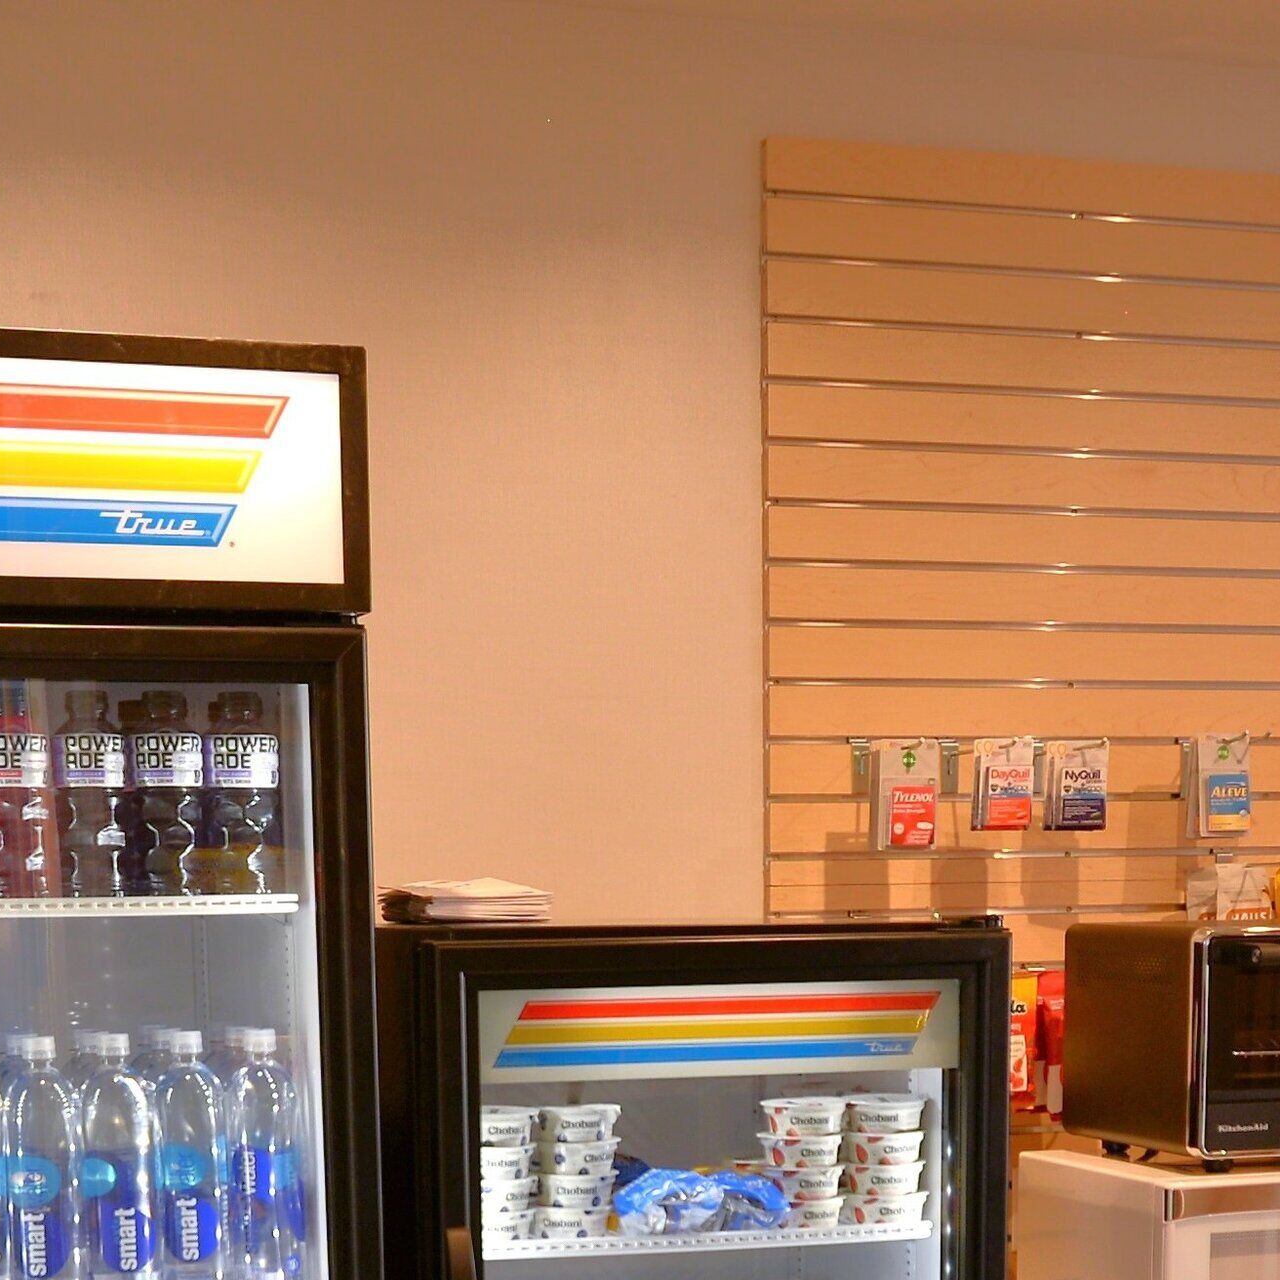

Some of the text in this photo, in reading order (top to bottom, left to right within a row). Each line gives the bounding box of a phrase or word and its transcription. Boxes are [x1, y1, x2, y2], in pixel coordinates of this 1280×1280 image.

[99, 510, 205, 536] true
[135, 737, 199, 751] POWER
[214, 738, 276, 752] POWER
[66, 753, 105, 768] ADE
[136, 753, 170, 768] ADE
[215, 754, 250, 768] ADE
[991, 769, 1030, 782] DayQuil
[1065, 770, 1100, 782] NyQuil
[1211, 786, 1247, 798] ALEVE
[860, 1113, 898, 1122] Chobani
[1218, 1123, 1269, 1133] KitchenAid
[177, 1197, 199, 1262] smart
[23, 1212, 47, 1278] smart
[115, 1207, 137, 1272] smart
